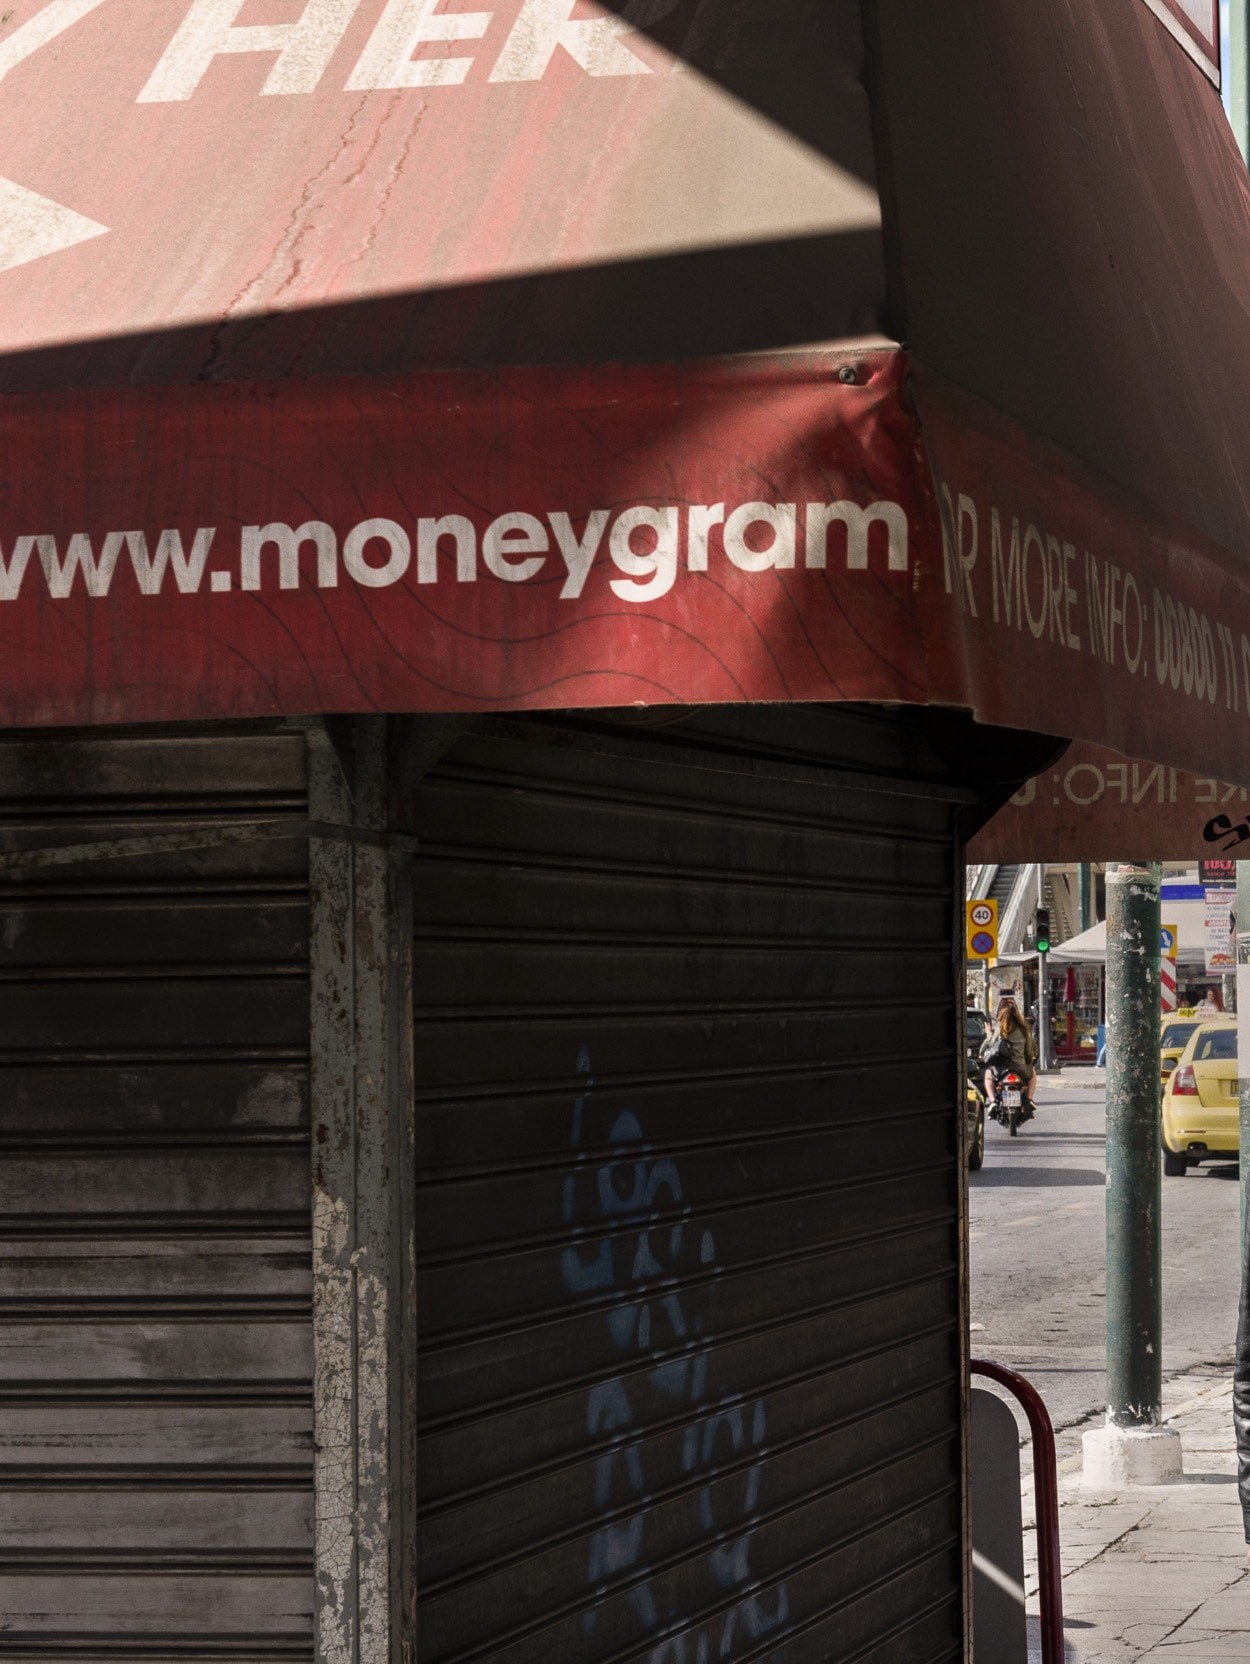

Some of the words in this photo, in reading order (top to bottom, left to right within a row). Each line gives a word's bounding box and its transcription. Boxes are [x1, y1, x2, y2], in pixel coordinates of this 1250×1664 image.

[991, 505, 1081, 651] MORE
[1084, 550, 1149, 678] INFO:
[1152, 587, 1217, 704] 00800
[975, 910, 989, 920] 40
